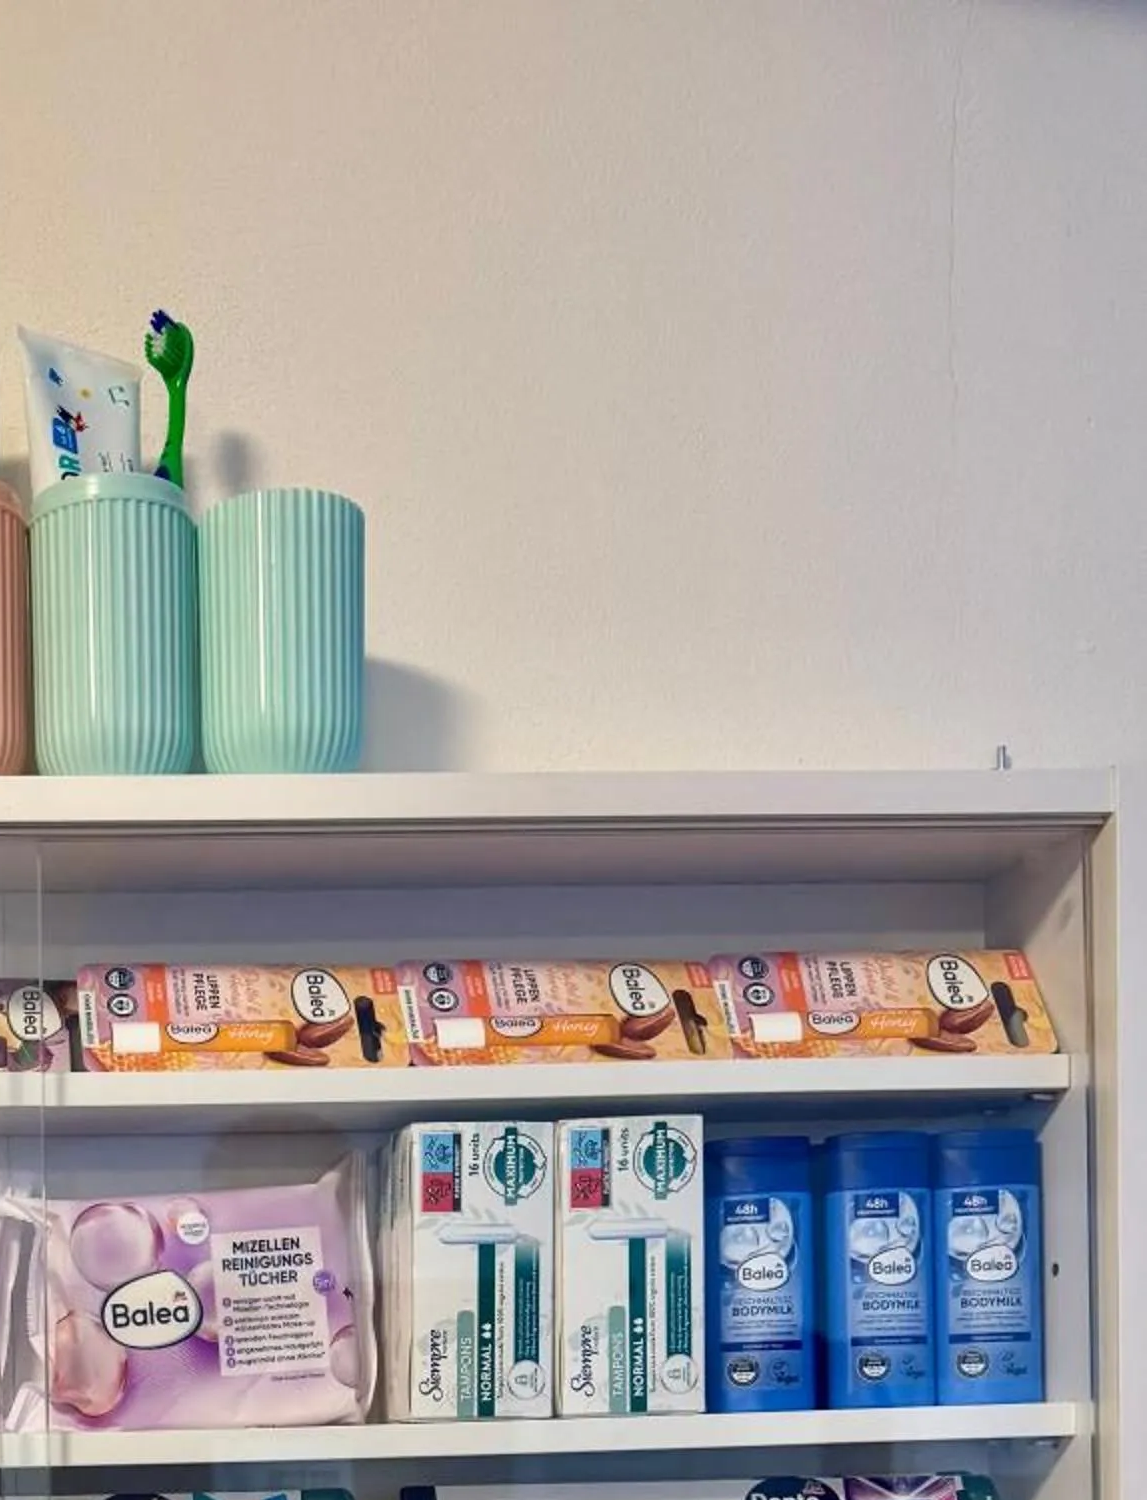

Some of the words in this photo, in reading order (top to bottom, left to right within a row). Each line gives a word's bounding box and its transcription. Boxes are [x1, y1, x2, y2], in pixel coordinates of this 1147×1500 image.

[622, 969, 646, 1011] Balea
[941, 960, 965, 1004] Balea
[206, 975, 221, 1009] LIPPEN
[306, 975, 325, 1018] Balea
[22, 991, 42, 1036] Balea
[470, 1162, 479, 1177] 16
[505, 1134, 517, 1198] MAXIMUM
[618, 1157, 629, 1172] 16
[656, 1130, 667, 1194] MAXIMUM
[866, 1198, 888, 1209] 48h
[964, 1196, 987, 1207] 48h
[735, 1205, 758, 1216] 48h
[232, 1238, 300, 1255] MIZELLEN
[222, 1253, 313, 1272] REINIGUNGS
[873, 1261, 912, 1275] Balea
[971, 1259, 1013, 1272] Balea
[240, 1271, 298, 1287] TÜCHER
[742, 1266, 784, 1281] Balea
[862, 1300, 920, 1311] BODYMILK
[961, 1296, 1022, 1308] BODYMILK
[112, 1303, 190, 1329] Balea
[732, 1306, 794, 1317] BODYMILK
[482, 1343, 492, 1401] NORMAL
[613, 1332, 623, 1398] TAMPONS
[633, 1337, 643, 1397] NORMAL
